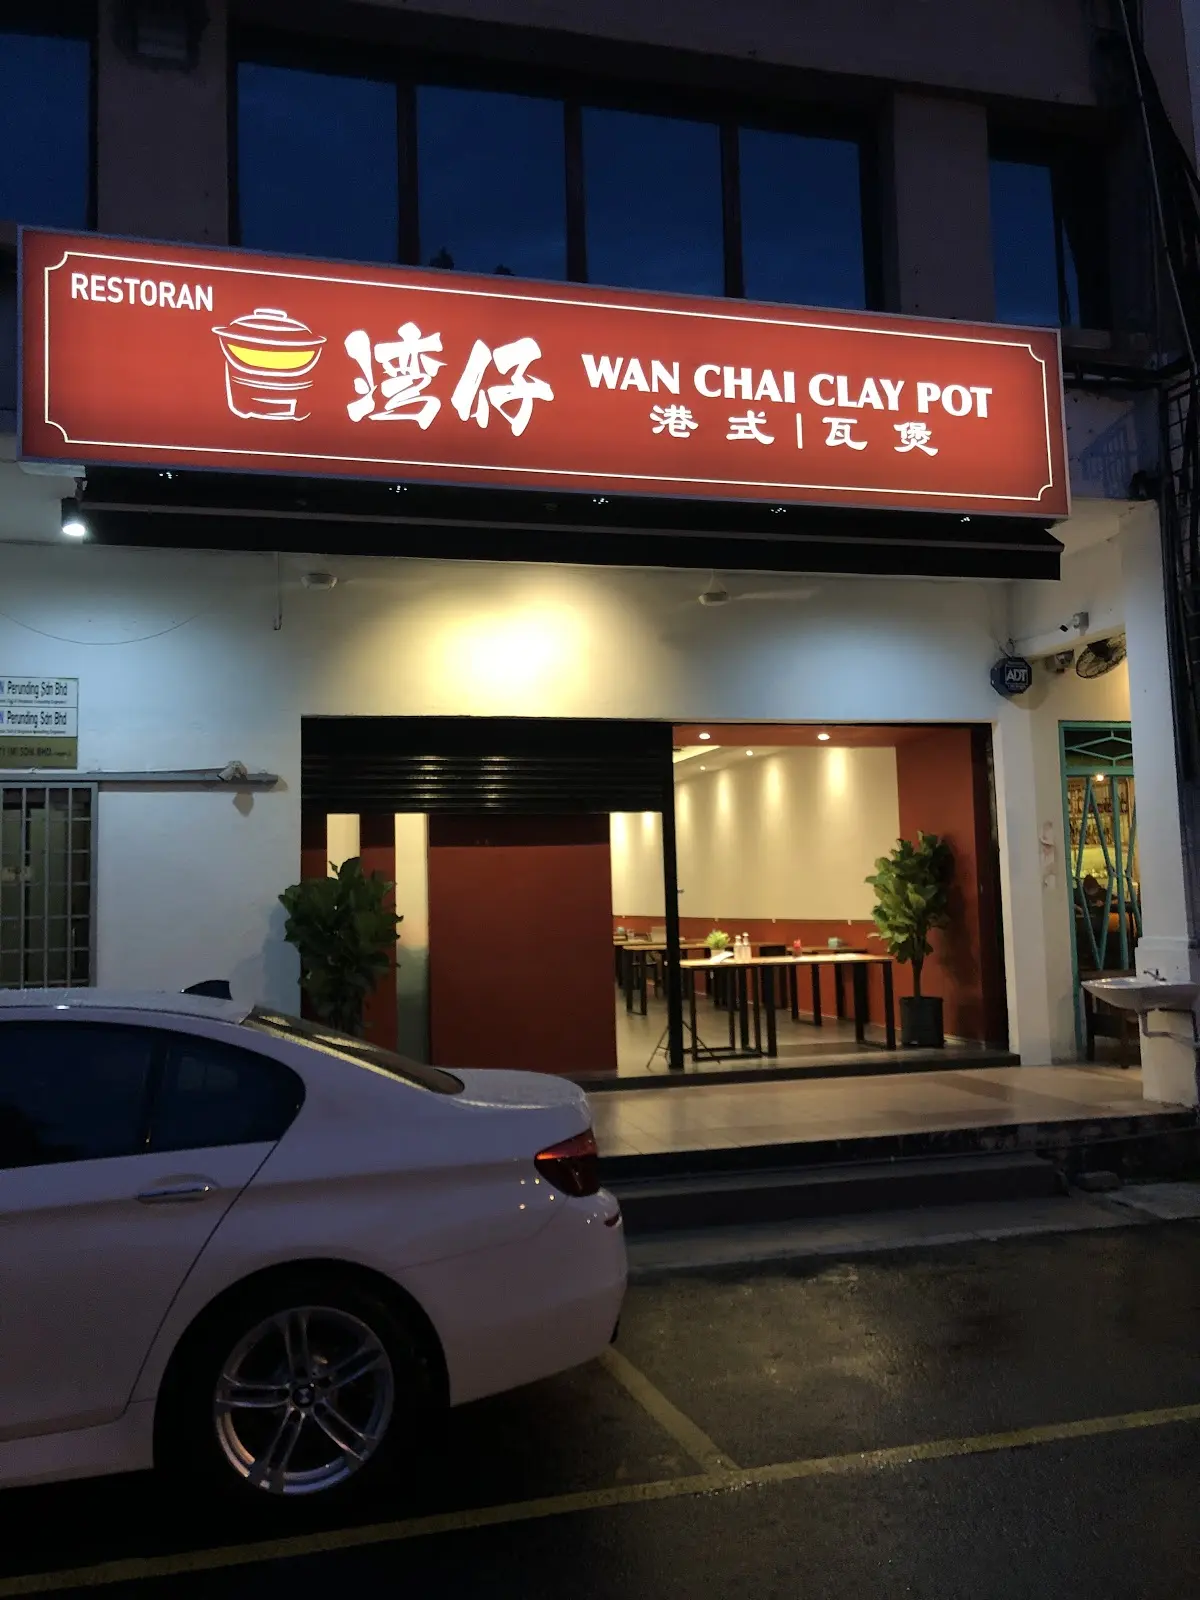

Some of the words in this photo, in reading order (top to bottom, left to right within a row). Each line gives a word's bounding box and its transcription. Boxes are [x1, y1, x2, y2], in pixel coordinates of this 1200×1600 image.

[71, 272, 214, 312] RESTORAN
[343, 321, 555, 437] 湾仔
[580, 353, 680, 395] WAN
[693, 363, 796, 404] CHAI
[808, 373, 905, 412] CLAY
[916, 381, 993, 419] POT
[55, 682, 68, 696] Bhd
[1006, 668, 1028, 682] ADT
[7, 710, 38, 729] Perunding
[40, 711, 53, 726] Sdn
[54, 711, 67, 726] Bhd
